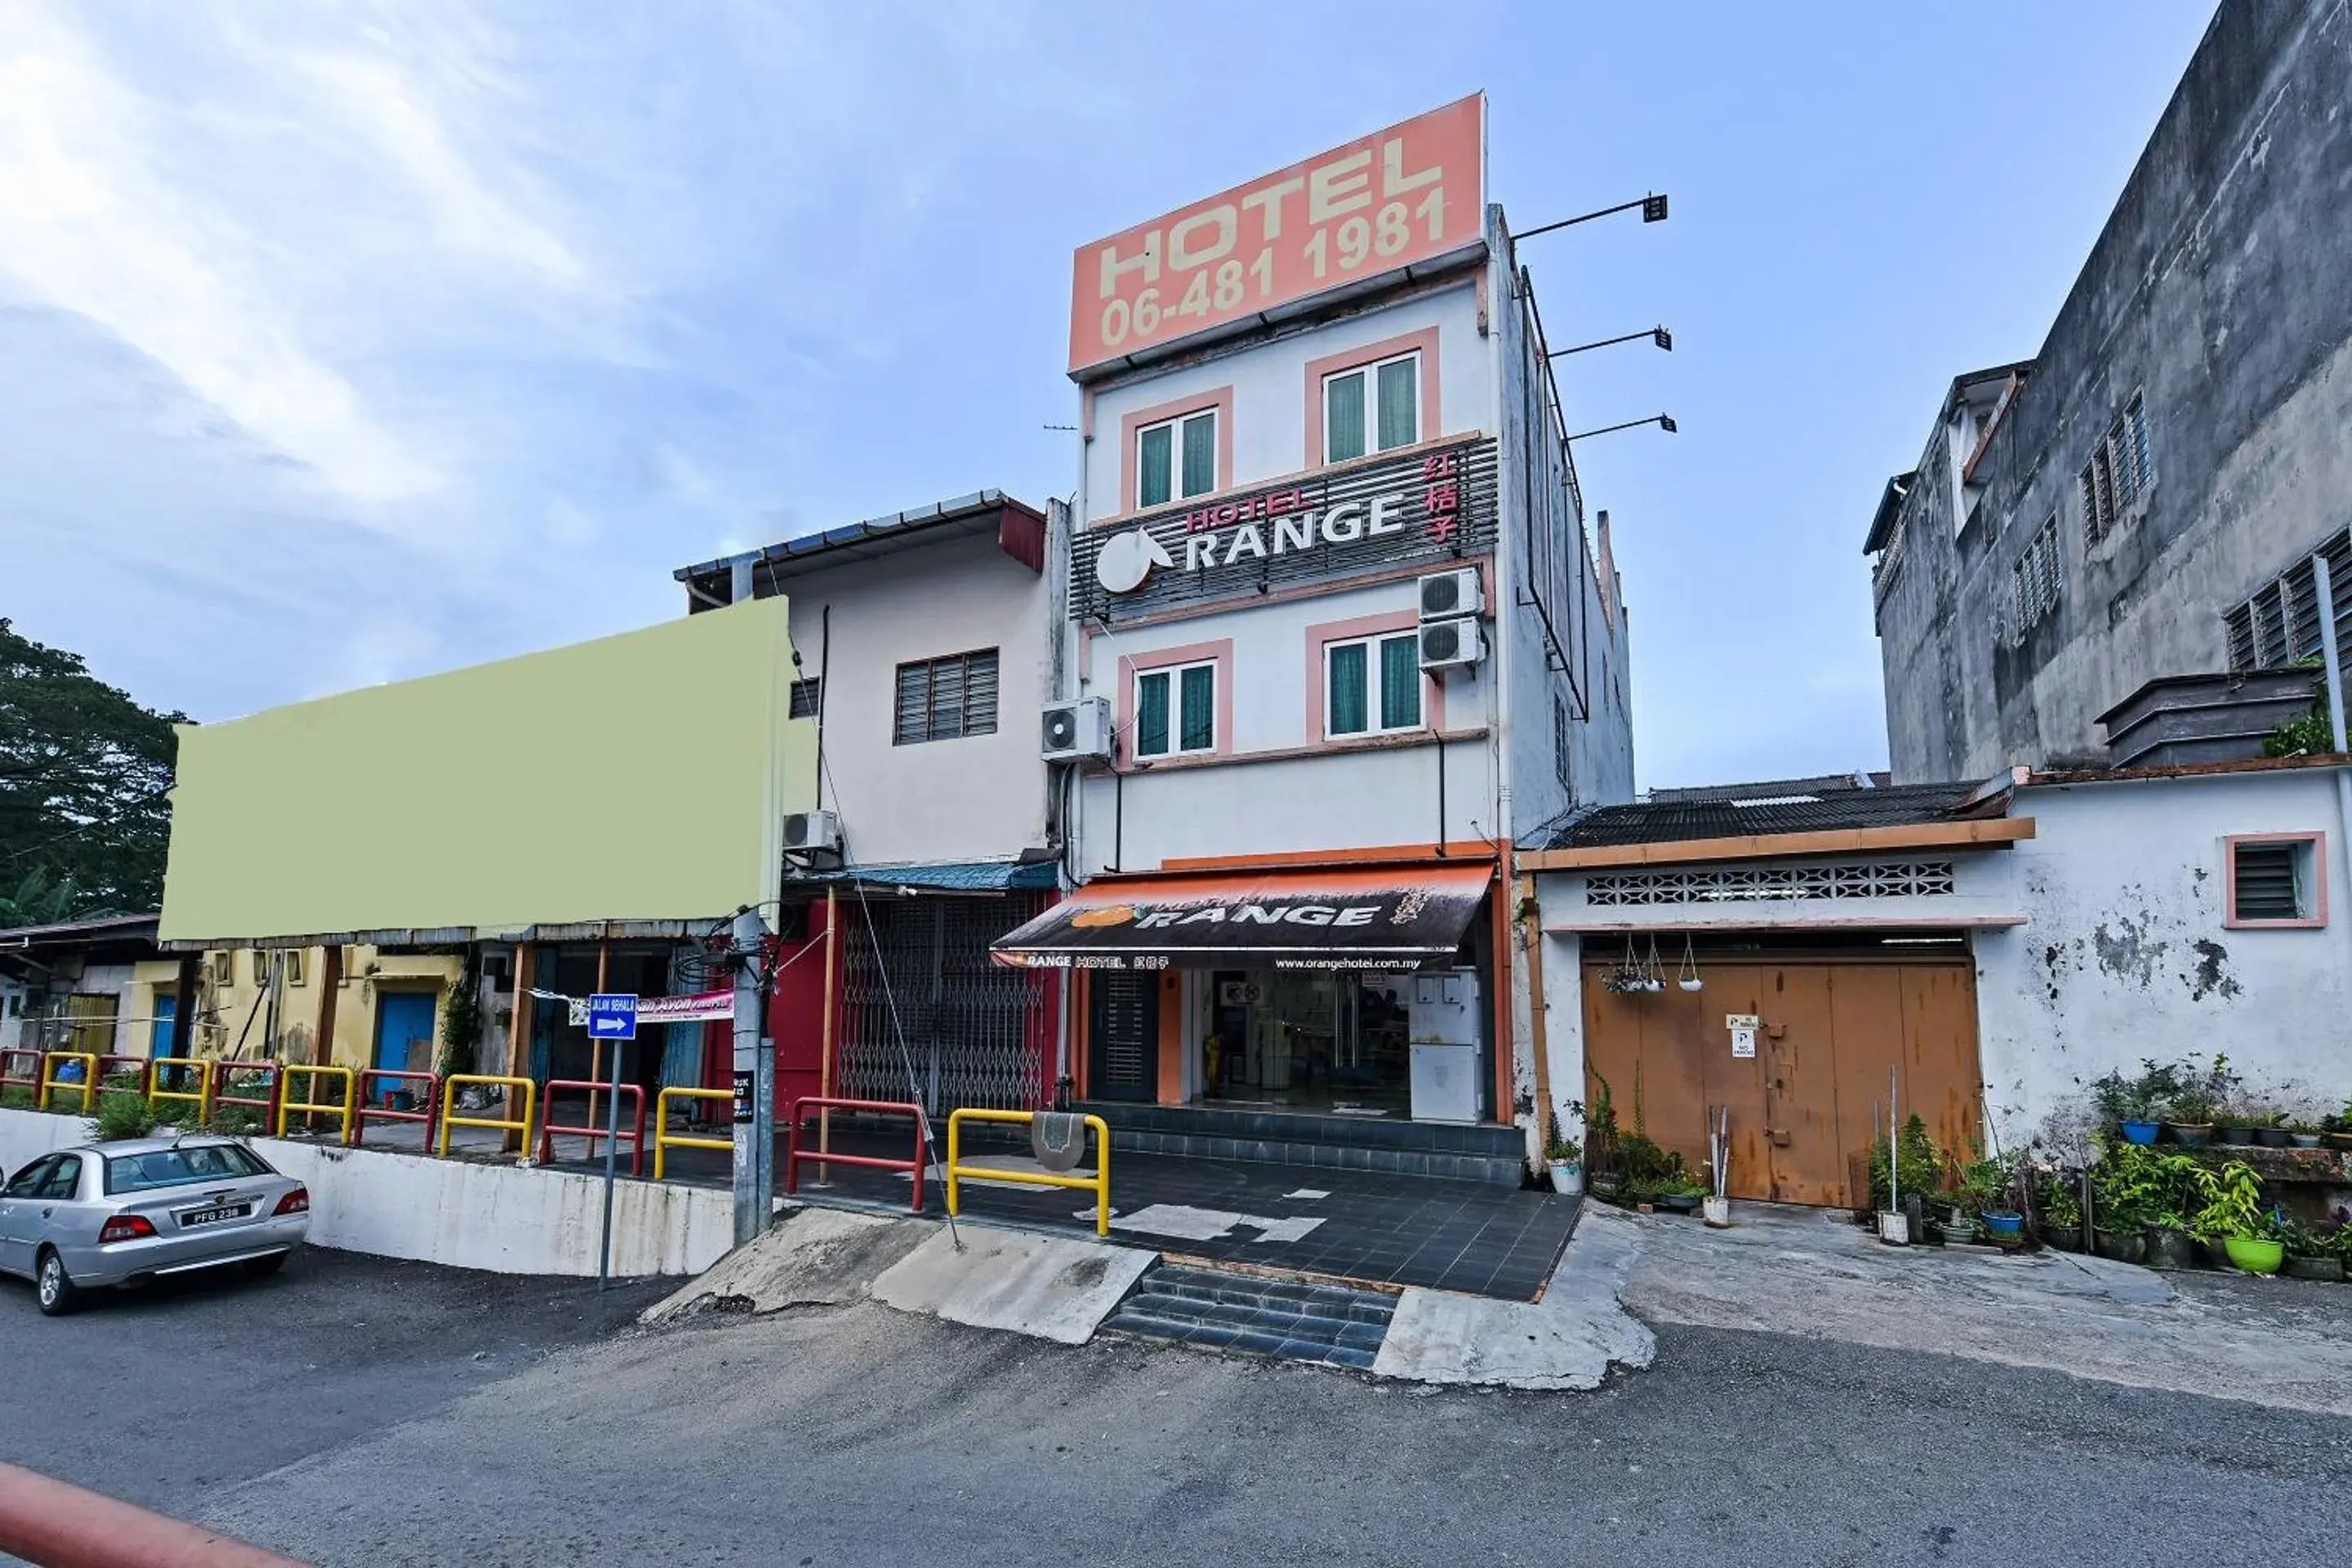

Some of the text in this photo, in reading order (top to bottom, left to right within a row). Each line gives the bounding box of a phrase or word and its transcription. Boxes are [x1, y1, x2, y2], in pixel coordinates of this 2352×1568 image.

[1100, 137, 1442, 299] HOTEL
[1101, 186, 1445, 347] 06-481 1981
[1186, 488, 1316, 532] HOTEL
[1423, 452, 1458, 543] 红桔子
[1185, 493, 1406, 572] RANGE
[1134, 904, 1382, 929] RANGE
[1027, 956, 1071, 967] RANGE
[1075, 956, 1126, 969] HOTEL
[1275, 957, 1422, 971] www.orangehotel.com.my
[194, 1212, 216, 1223] PFG
